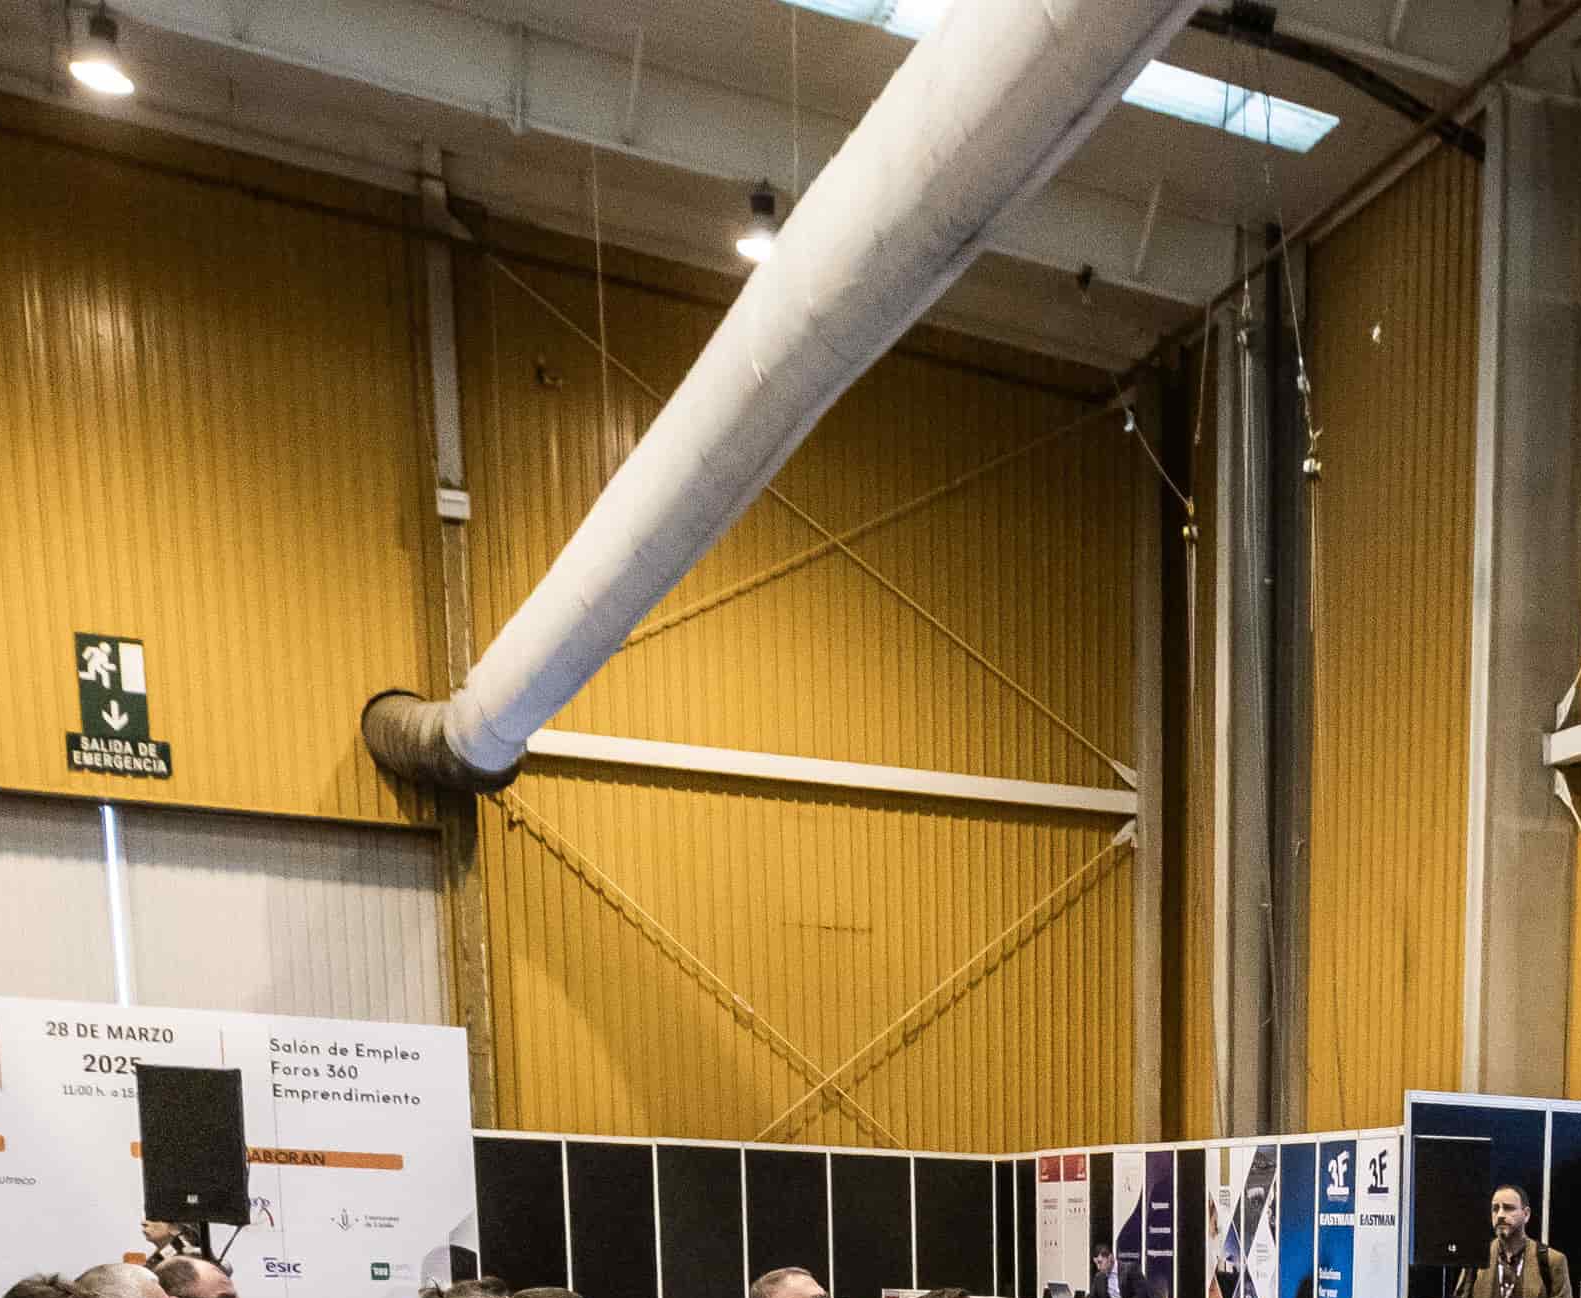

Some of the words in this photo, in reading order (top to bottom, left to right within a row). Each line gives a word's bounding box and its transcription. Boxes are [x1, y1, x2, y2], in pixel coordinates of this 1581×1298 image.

[79, 735, 135, 757] SALIDA
[138, 741, 159, 759] DE
[72, 749, 168, 775] EMERGENCIA
[45, 1021, 69, 1038] 28
[75, 1022, 101, 1040] DE
[106, 1025, 175, 1045] MARZO
[269, 1038, 325, 1057] Salón
[327, 1041, 350, 1058] de
[354, 1043, 421, 1063] Empleo
[82, 1054, 144, 1076] 2025
[270, 1060, 321, 1079] Foros
[326, 1064, 359, 1080] 360
[272, 1083, 422, 1107] Emprendimiento
[250, 1150, 327, 1166] ABORAN
[1368, 1149, 1388, 1187] 3F
[1359, 1213, 1396, 1227] EASTMAN
